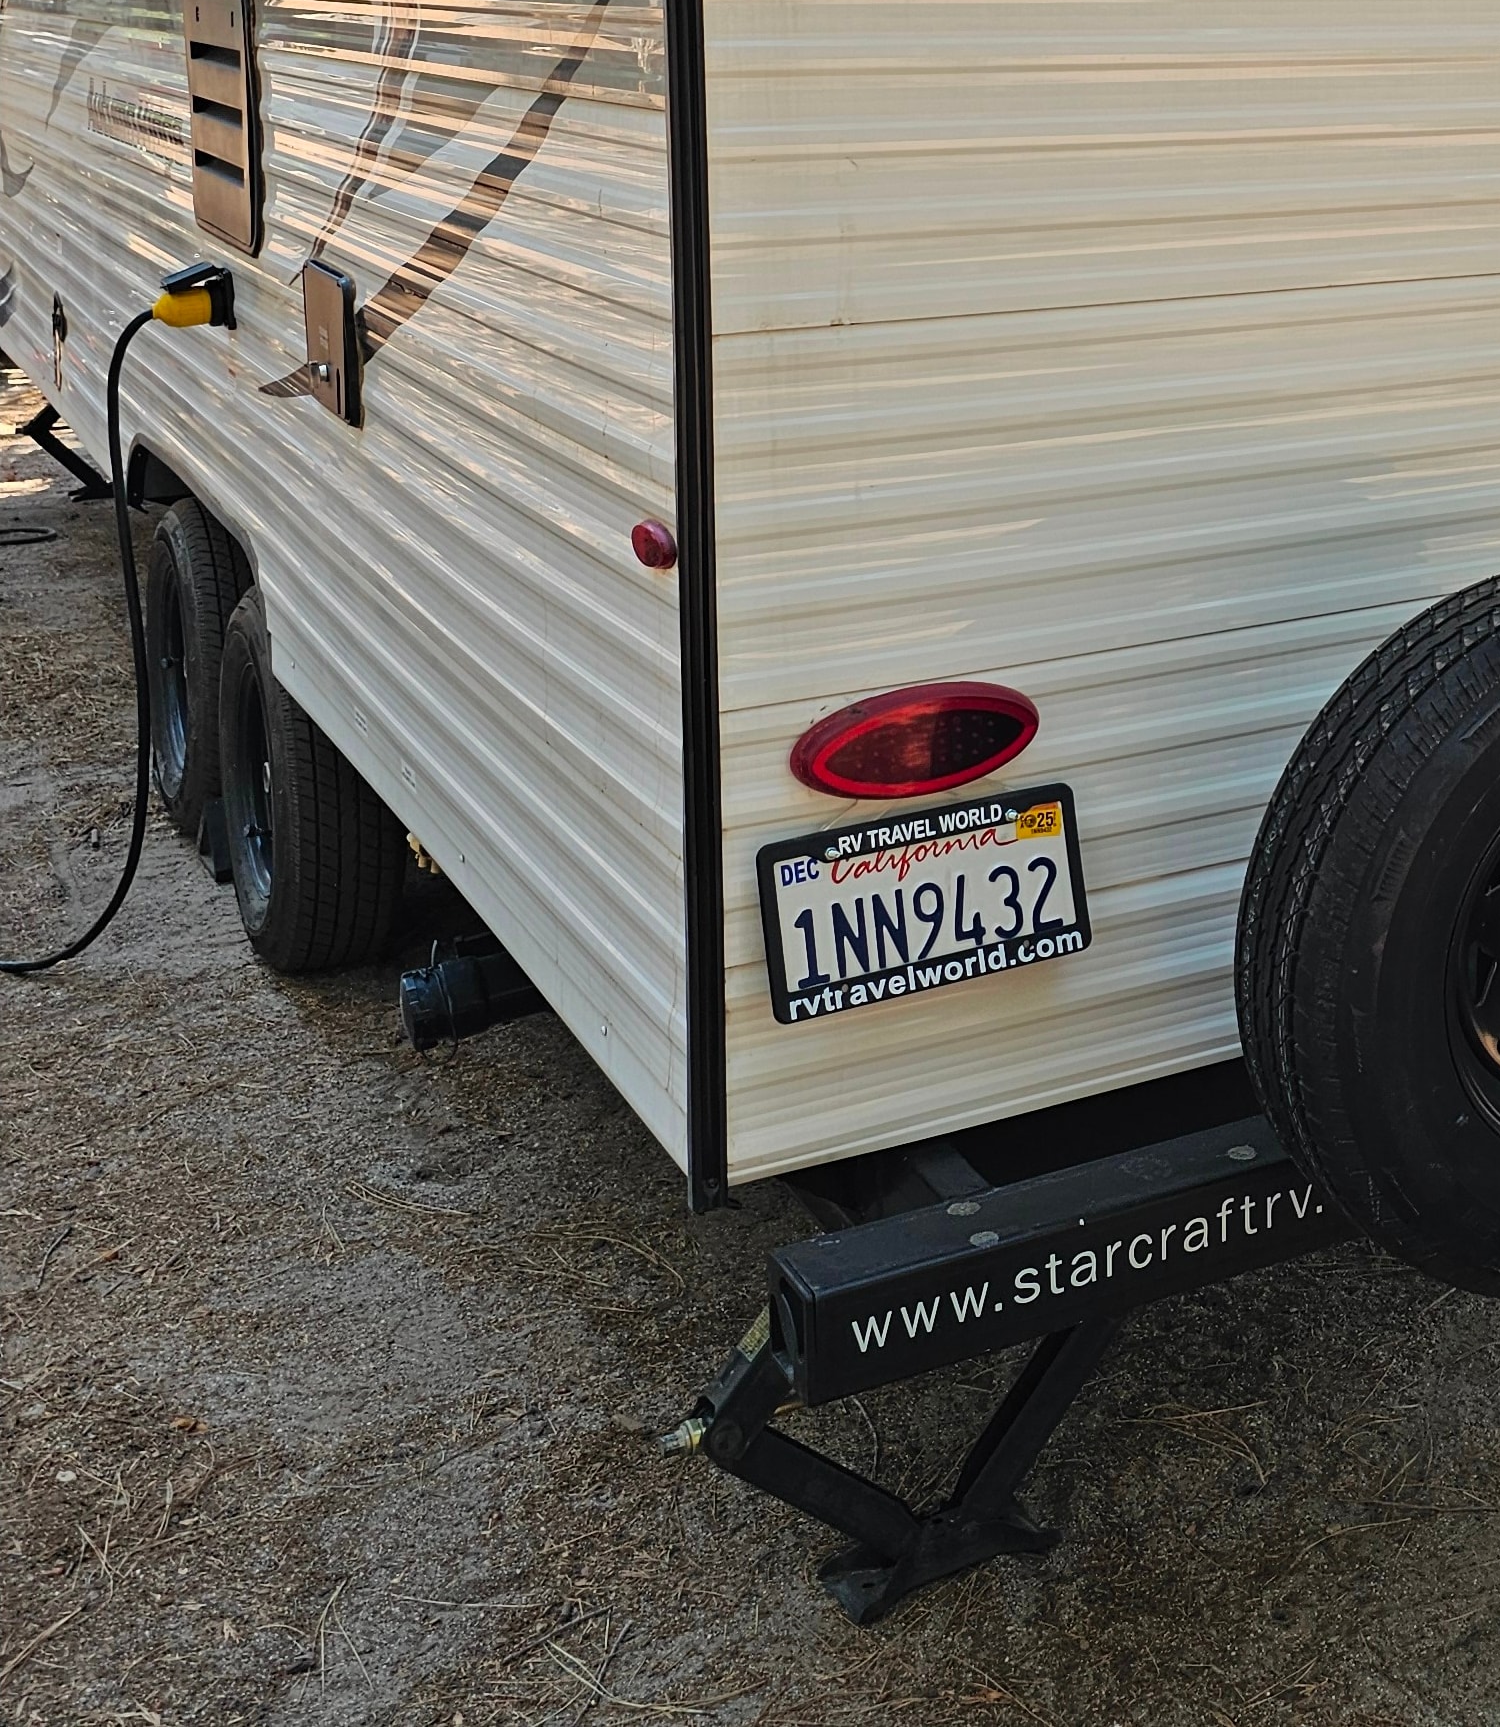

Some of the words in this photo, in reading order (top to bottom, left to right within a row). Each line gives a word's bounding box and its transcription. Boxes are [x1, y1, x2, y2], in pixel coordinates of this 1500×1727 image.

[838, 833, 863, 856] RV
[867, 819, 936, 851] TRAVEL
[938, 804, 1003, 832] WORLD
[1037, 811, 1054, 828] 25
[780, 858, 820, 887] DEC
[830, 827, 1020, 885] California
[793, 856, 1065, 990] 1NN9432
[789, 929, 1083, 1020] rvtravelworld.com
